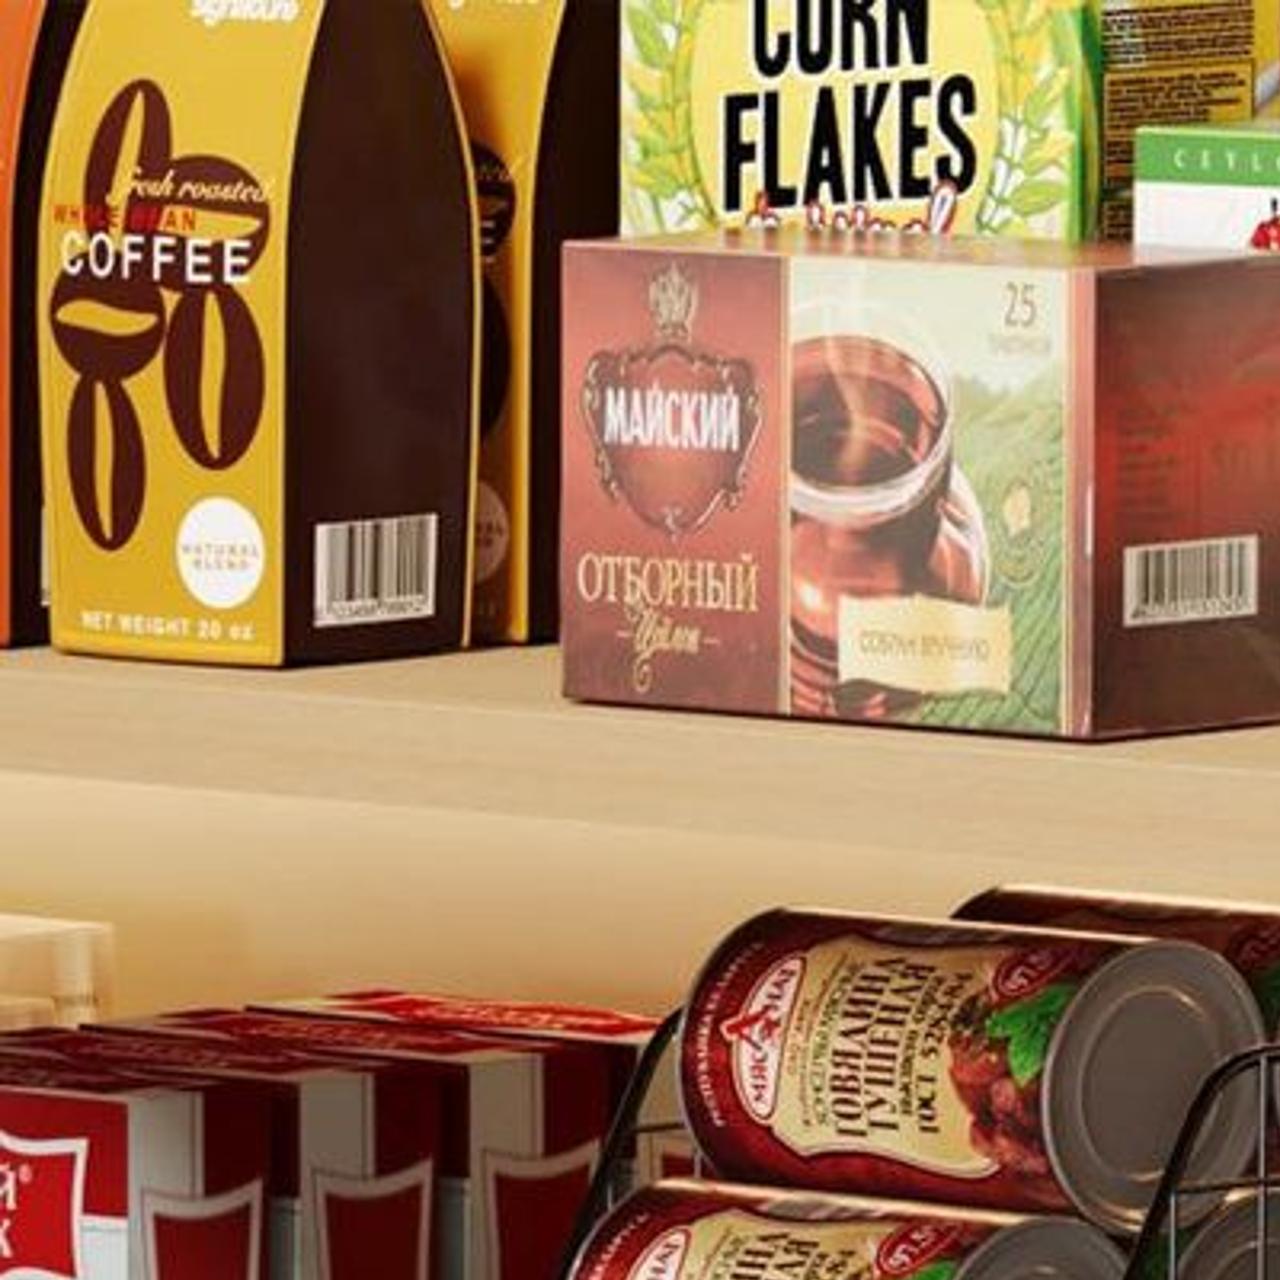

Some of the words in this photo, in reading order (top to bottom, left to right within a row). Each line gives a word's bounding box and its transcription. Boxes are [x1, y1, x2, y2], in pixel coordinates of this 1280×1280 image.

[724, 75, 977, 210] FLAKES
[61, 229, 252, 284] COFFEE
[1003, 281, 1038, 327] 25
[604, 384, 741, 452] МАЙСКИЙ
[577, 552, 759, 612] ОТБОРНЫЙ
